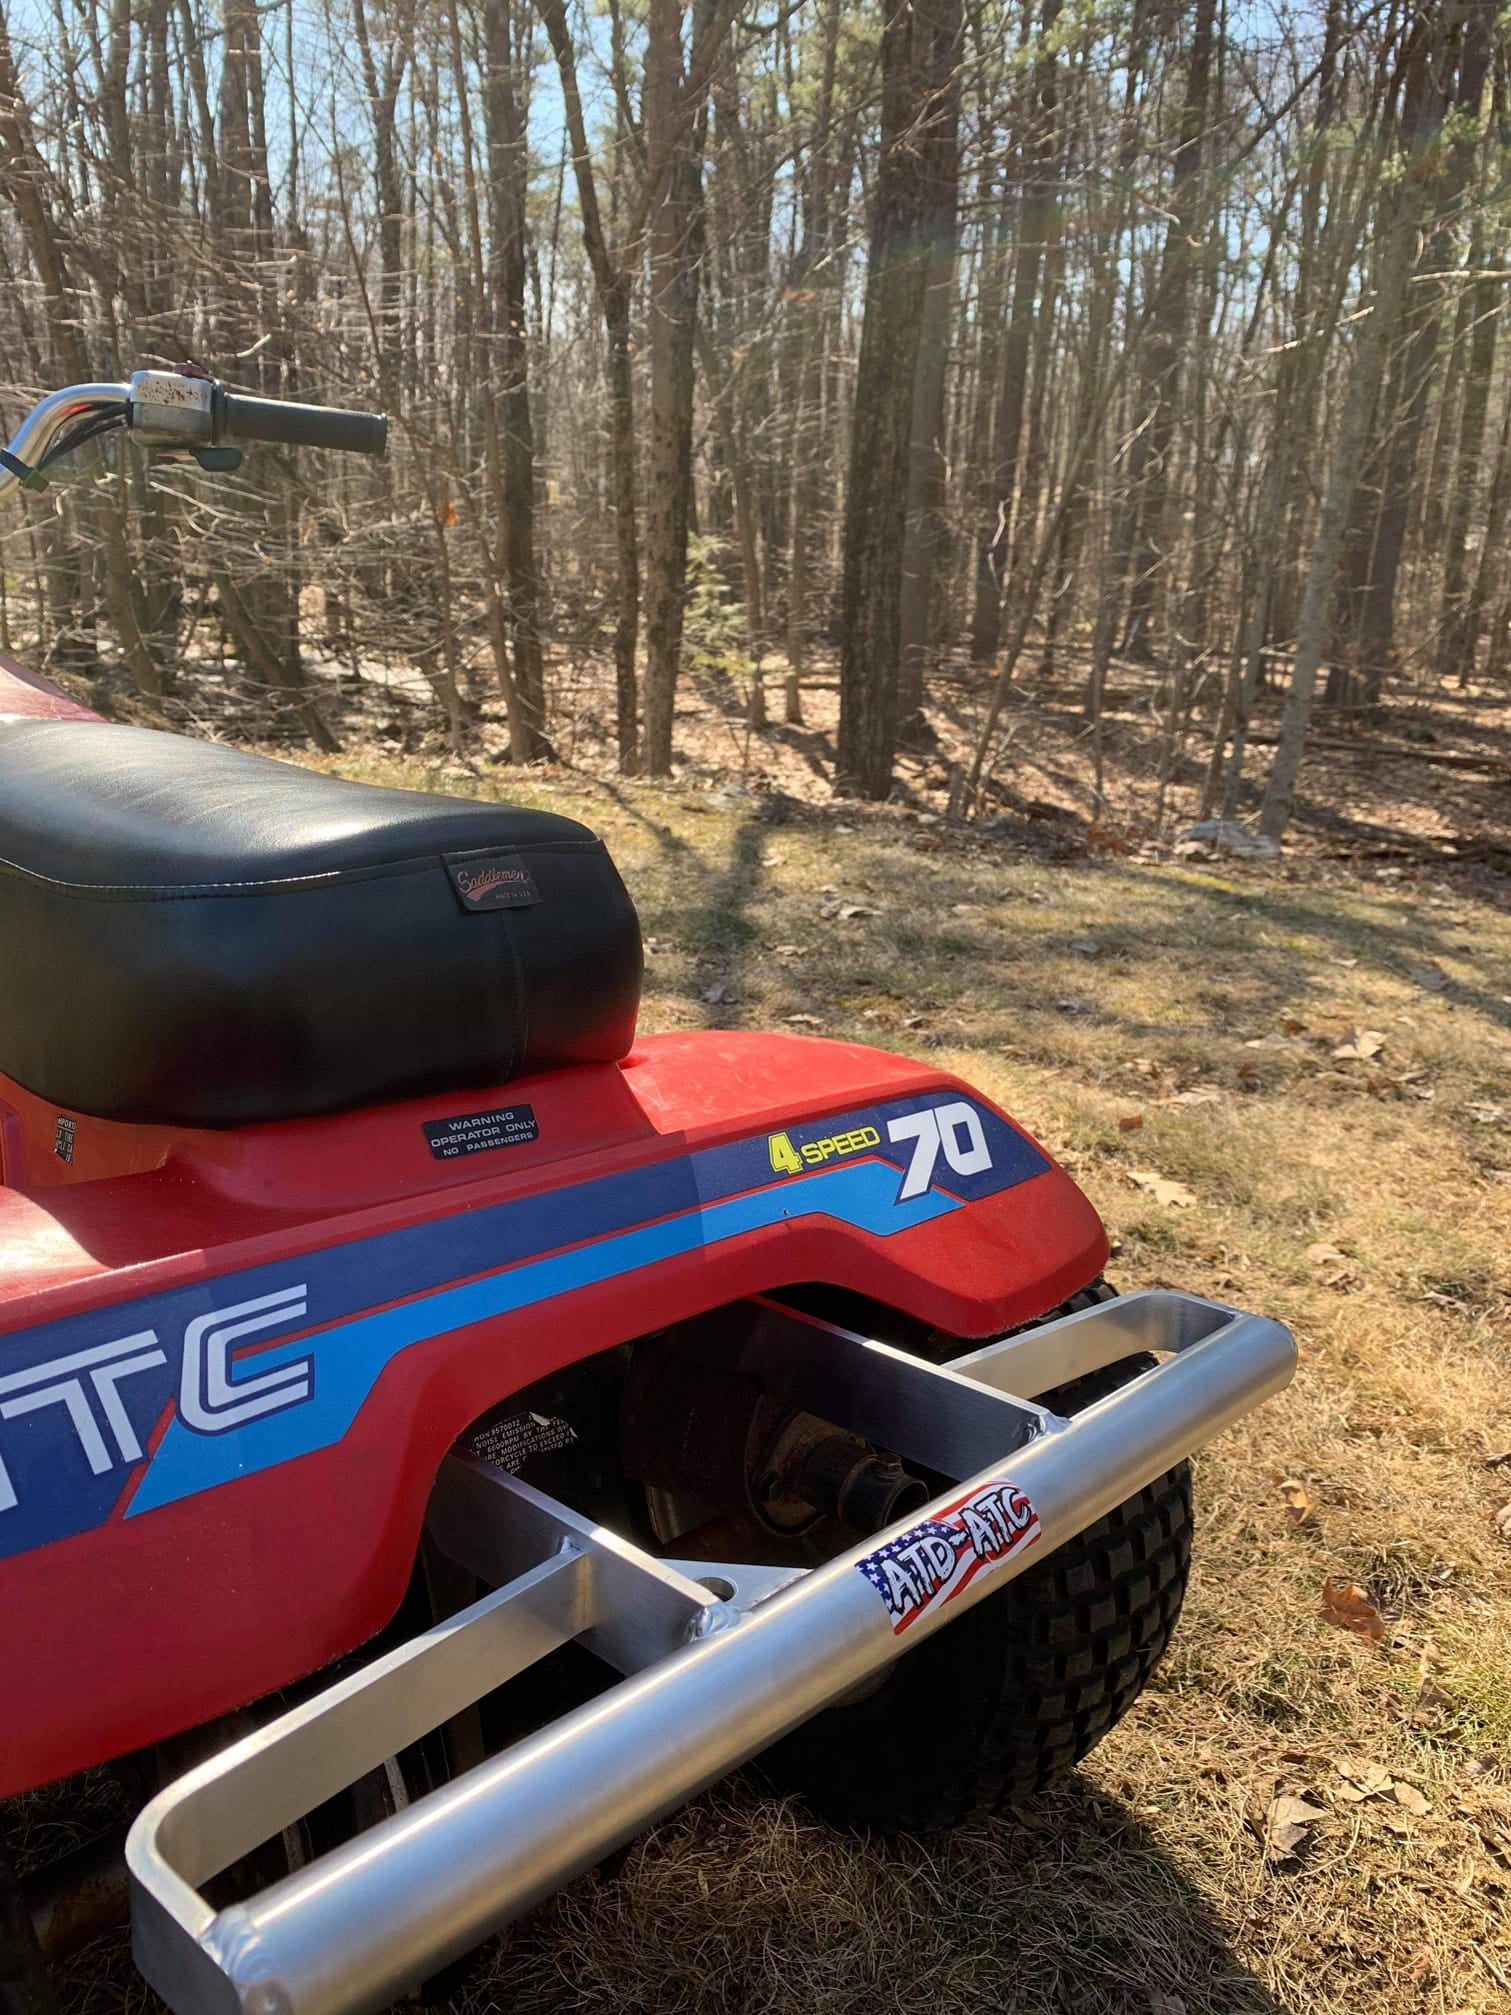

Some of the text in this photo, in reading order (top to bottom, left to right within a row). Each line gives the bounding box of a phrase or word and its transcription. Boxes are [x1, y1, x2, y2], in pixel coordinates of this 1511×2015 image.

[457, 867, 526, 893] Saddlemen
[431, 1120, 536, 1147] OPERATOR ONLY
[449, 1112, 514, 1131] WARNING
[443, 1132, 533, 1156] NO PASSENGERS
[768, 1126, 881, 1174] 4 SPEED
[886, 1101, 993, 1201] 70
[475, 1422, 536, 1450] NOISE EMISSION
[501, 1428, 555, 1455] MODIFICATIONS
[539, 1432, 565, 1448] EXCEED
[879, 1485, 1032, 1616] ATD-ATC
